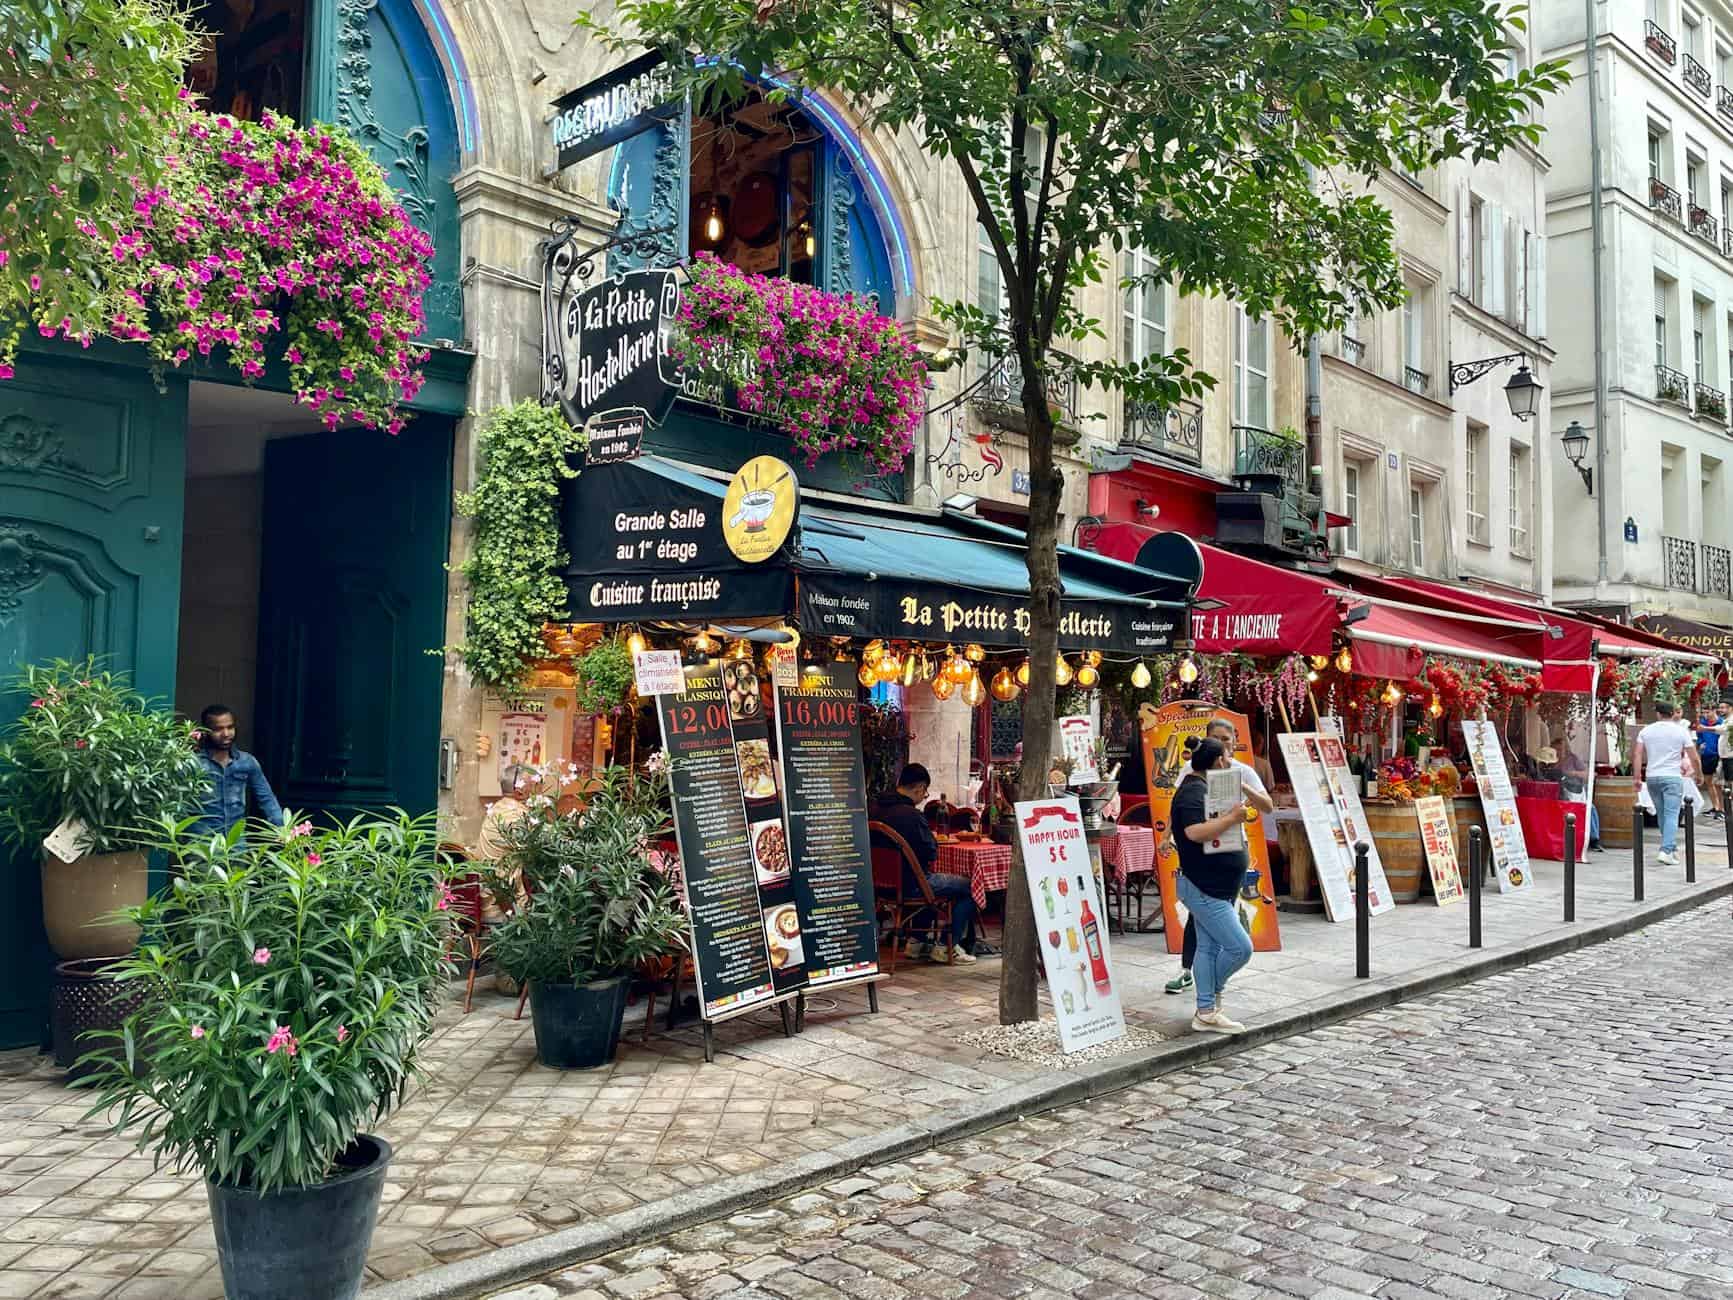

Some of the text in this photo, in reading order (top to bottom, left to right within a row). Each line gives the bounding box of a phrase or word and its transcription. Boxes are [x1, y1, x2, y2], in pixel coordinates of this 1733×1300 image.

[584, 287, 655, 331] La Petite
[579, 330, 655, 409] Hostellerie
[615, 508, 706, 532] Grande Salle
[617, 544, 634, 560] au
[657, 540, 697, 563] étage
[590, 576, 721, 609] Cuisine française
[809, 593, 870, 611] Maison fondée
[824, 613, 856, 626] en 1902
[900, 596, 933, 627] La
[940, 601, 1008, 633] Petite
[1131, 620, 1151, 631] Cuisine
[1211, 615, 1219, 639] A
[1225, 613, 1282, 639] L'ANCIENNE
[647, 654, 668, 664] Salle
[686, 677, 720, 689] MENU
[803, 674, 834, 687] MENU
[782, 687, 856, 698] TRADITIONNEL
[784, 700, 857, 728] 16,00€
[1028, 828, 1081, 845] HAPPY HOUR
